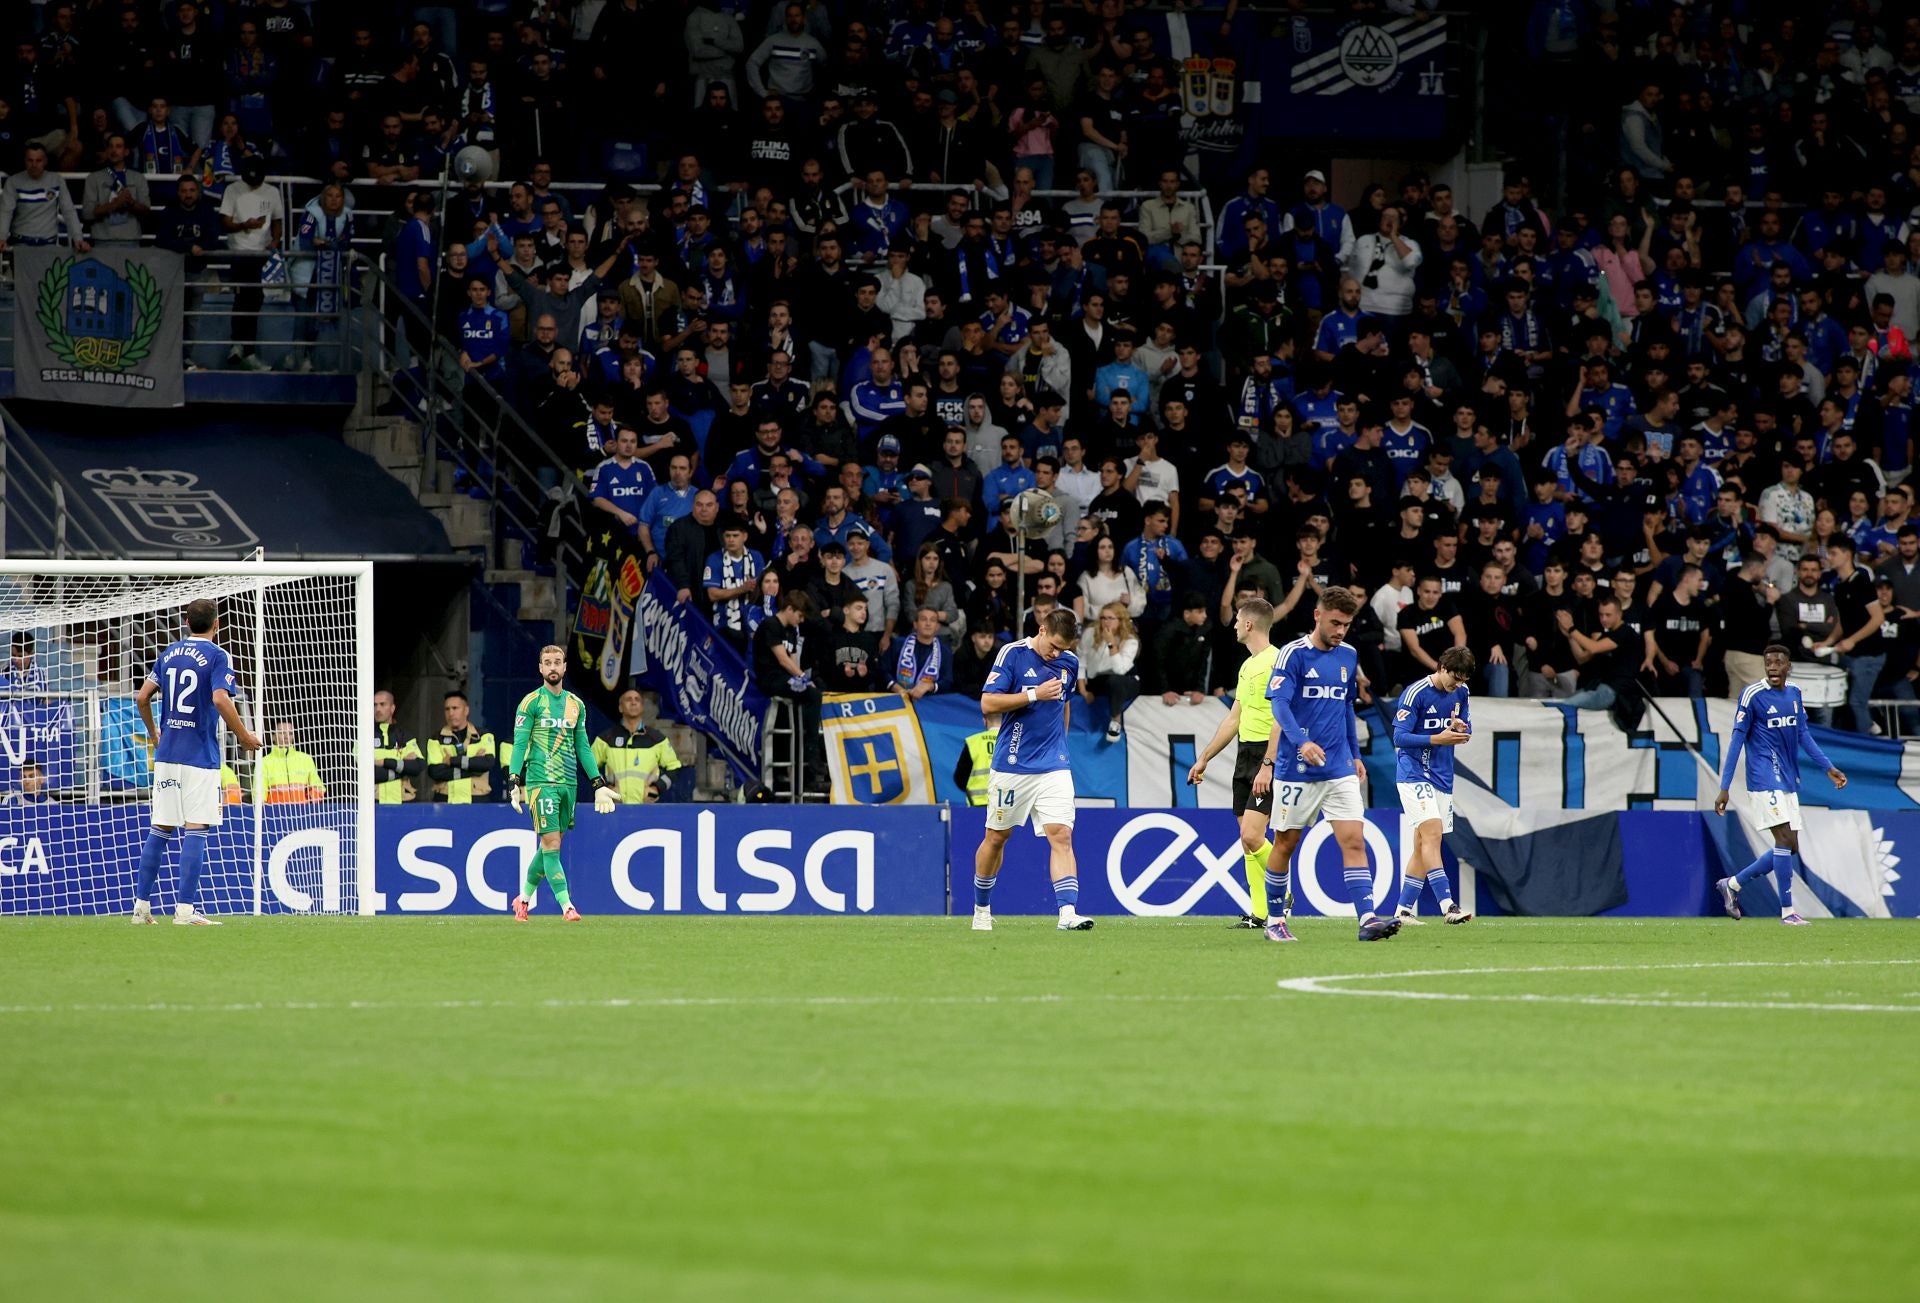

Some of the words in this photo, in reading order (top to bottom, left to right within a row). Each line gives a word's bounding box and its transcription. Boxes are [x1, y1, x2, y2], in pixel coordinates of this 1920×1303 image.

[751, 149, 790, 161] OVIEDO
[1015, 210, 1042, 225] 994
[463, 329, 494, 339] DIGI
[41, 369, 82, 382] SECC.
[83, 370, 155, 390] NARANCO
[936, 402, 964, 413] FCK
[1386, 449, 1420, 459] DIGI
[612, 487, 644, 497] DIGI
[163, 647, 184, 664] DANI
[184, 648, 208, 667] CALVO
[166, 667, 199, 715] 12
[841, 702, 854, 718] R
[864, 699, 877, 714] O
[1008, 721, 1021, 754] OVIEDO
[997, 788, 1015, 808] 14
[1281, 784, 1303, 807] 27
[1414, 783, 1434, 801] 29
[1769, 790, 1778, 806] 3
[538, 798, 554, 816] 13
[610, 809, 875, 913] alsa
